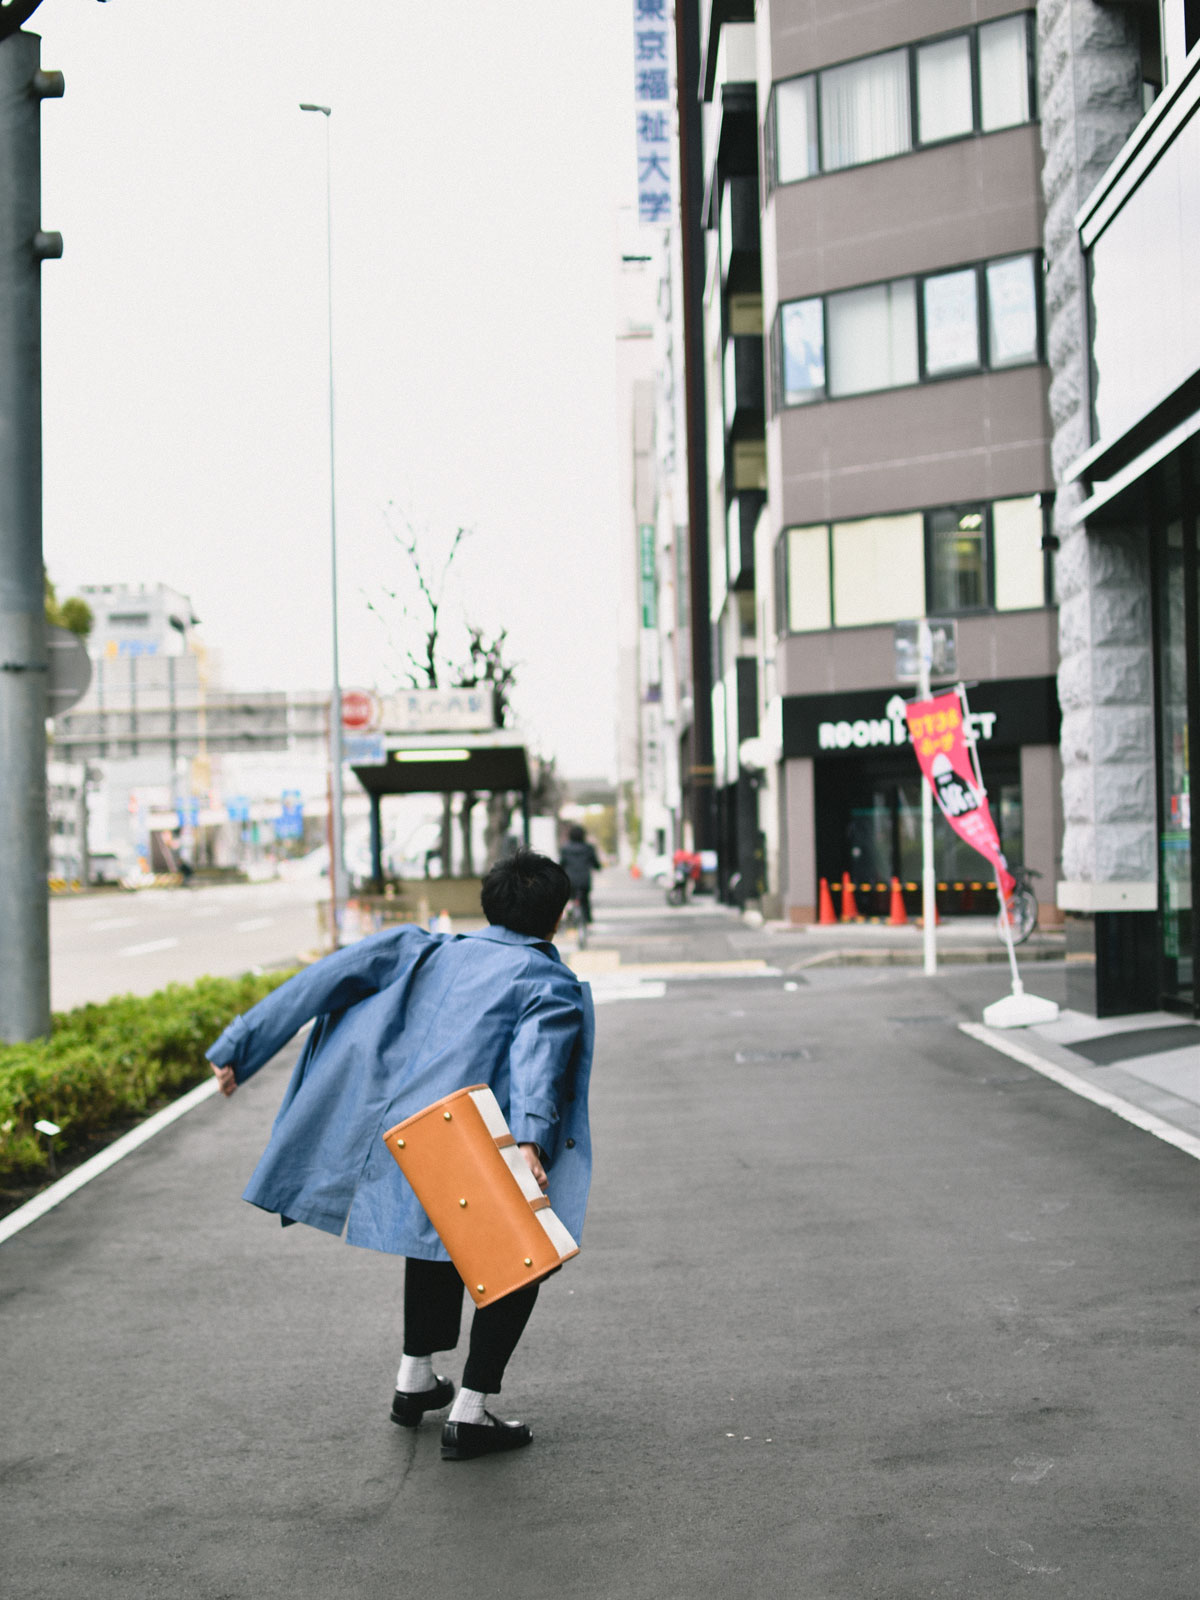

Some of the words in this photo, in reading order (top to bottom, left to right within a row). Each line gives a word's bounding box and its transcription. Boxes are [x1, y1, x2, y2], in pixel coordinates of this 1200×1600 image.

[636, 0, 671, 222] 東京福祉大学
[819, 719, 891, 749] ROOM
